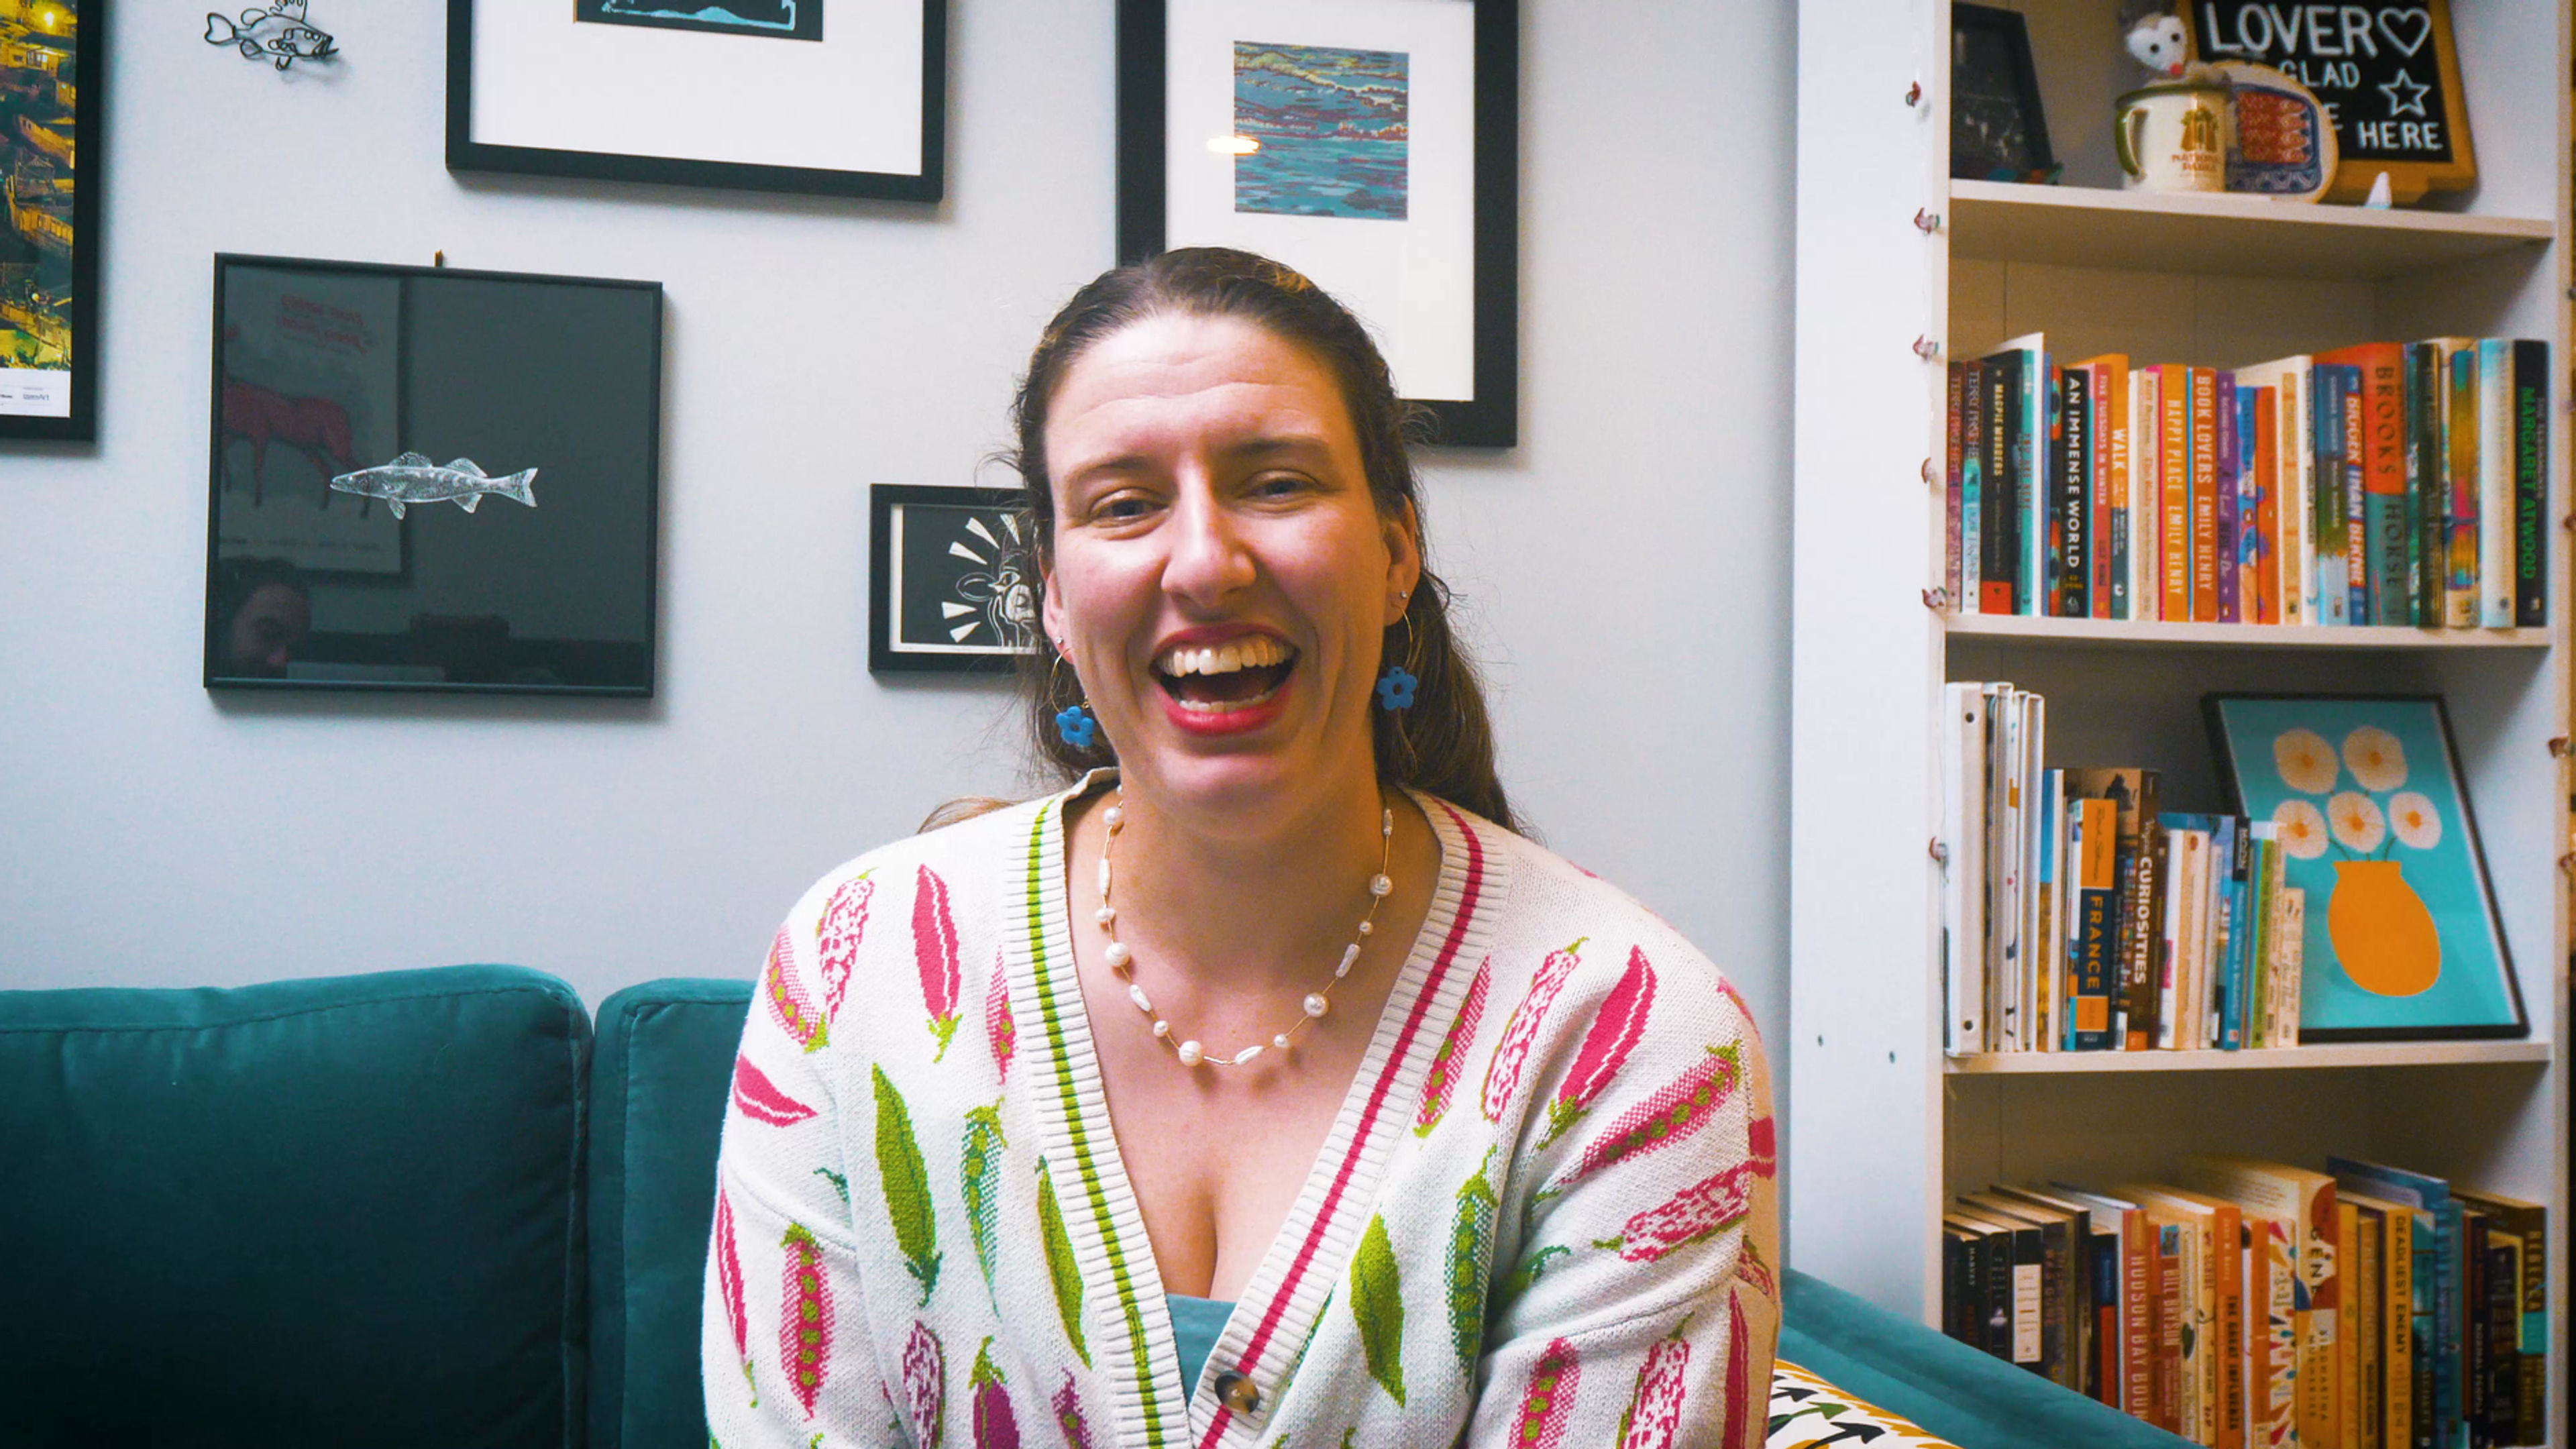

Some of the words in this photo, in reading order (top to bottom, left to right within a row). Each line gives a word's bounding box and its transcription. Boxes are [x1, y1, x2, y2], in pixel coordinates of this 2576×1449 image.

[2205, 3, 2379, 59] LOVER
[2281, 60, 2361, 89] GLAD
[2356, 120, 2444, 150] HERE
[1968, 370, 1980, 409] TERRY
[1994, 384, 2004, 423] MAGPIE
[2068, 378, 2081, 404] AN
[2099, 375, 2108, 396] FIVE
[2196, 376, 2212, 418] BOOK
[2099, 400, 2108, 449] TUESDAYS
[2167, 400, 2183, 443] HAPPY
[2346, 396, 2362, 464] BIGGER
[2375, 366, 2396, 474] BROOKS
[2520, 387, 2536, 490] MARGARET
[1994, 427, 2004, 476] MURDERS
[2068, 410, 2081, 494] IMMENSE
[2099, 453, 2108, 464] IN
[2112, 429, 2127, 471] WALK
[2167, 449, 2183, 490] PLACE
[2196, 425, 2212, 484] LOVERS
[2098, 467, 2108, 505] WINTER
[2348, 469, 2363, 518] THAN
[2068, 500, 2081, 569] WORLD
[2168, 506, 2183, 545] EMILY
[2198, 496, 2212, 539] EMILY
[2521, 497, 2536, 580] ATWOOD
[2198, 545, 2212, 590] HENRY
[2349, 523, 2364, 586] BERNIE
[2383, 503, 2405, 588] HORSE
[2169, 552, 2184, 595] HENRY
[2239, 828, 2249, 870] MOON
[2086, 896, 2103, 989] FRANCE
[2134, 855, 2153, 985] CURIOSITIES
[2235, 927, 2243, 961] VIENNA
[2231, 972, 2241, 1020] BUDAPEST
[2310, 1226, 2323, 1294] GENE
[2396, 1215, 2407, 1297] DEADLIEST
[2528, 1230, 2542, 1310] REBECCA
[2130, 1256, 2147, 1328] HUDSON
[2163, 1269, 2180, 1293] BILL
[2163, 1299, 2181, 1347] BRYSON
[2228, 1295, 2239, 1316] THE
[2396, 1303, 2407, 1354] ENEMY
[2132, 1334, 2147, 1366] BAY
[2228, 1322, 2239, 1358] GREAT
[2475, 1323, 2483, 1370] NORMAL
[2132, 1373, 2148, 1424] BOUN
[2228, 1364, 2240, 1430] INFLUENZA
[2320, 1330, 2328, 1421] SIDDHARTHA
[2475, 1375, 2483, 1415] PEOPLE
